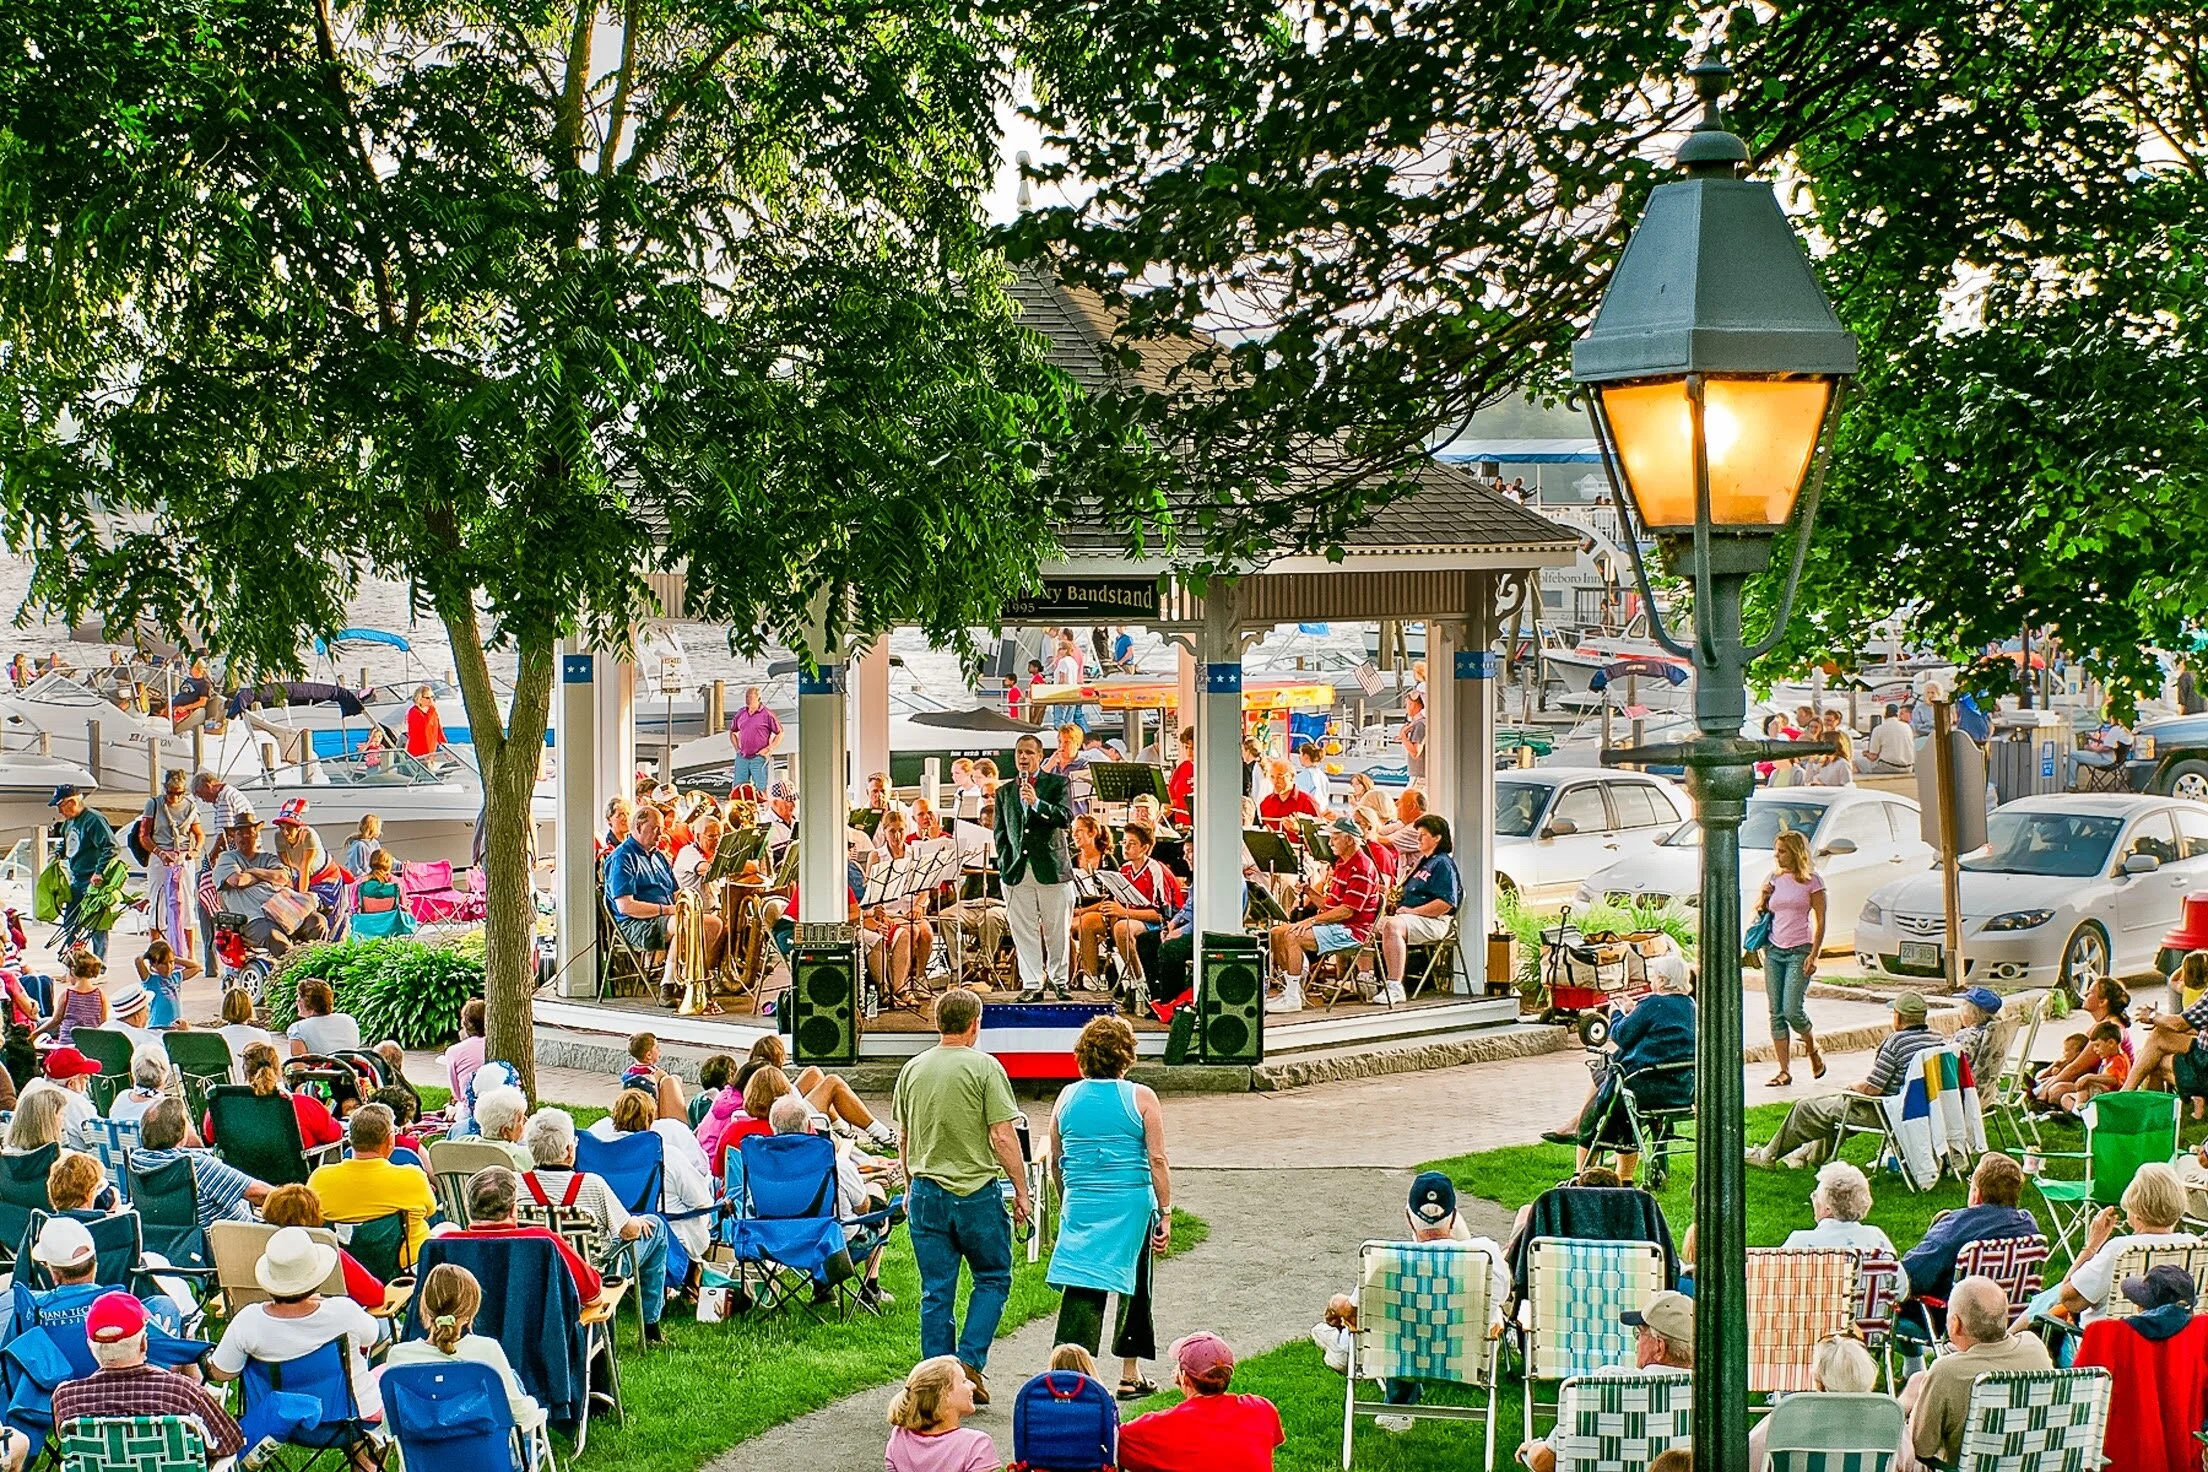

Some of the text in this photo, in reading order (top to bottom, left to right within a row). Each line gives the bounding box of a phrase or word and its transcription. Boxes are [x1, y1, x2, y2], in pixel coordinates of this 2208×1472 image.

[1583, 572, 1602, 584] Inn
[1067, 584, 1153, 609] Bandstand
[1006, 602, 1035, 613] 1995
